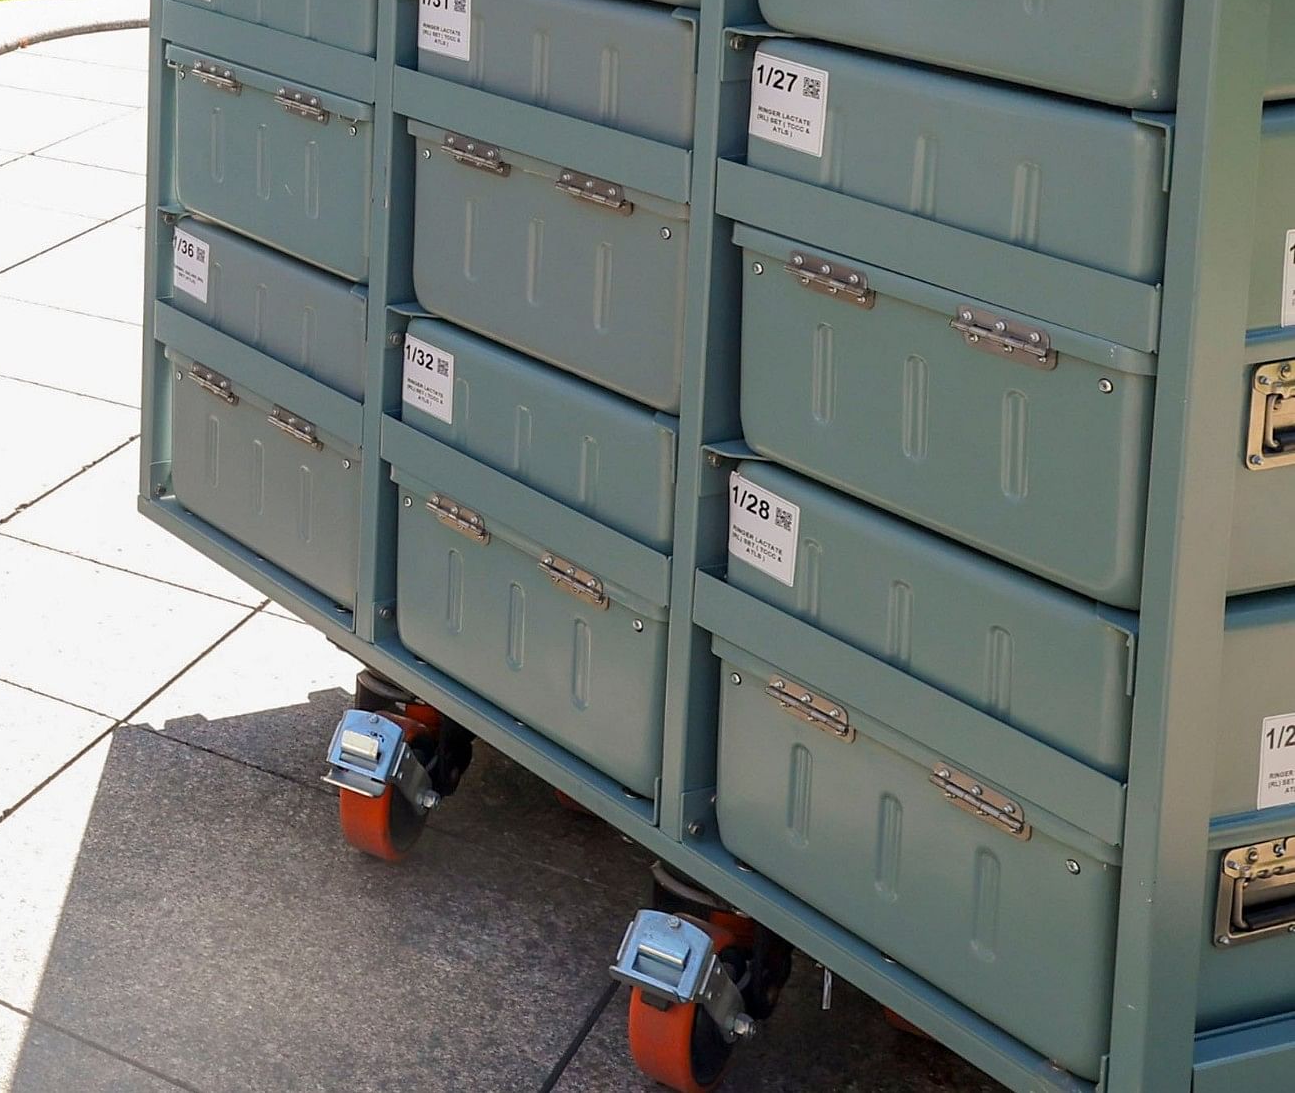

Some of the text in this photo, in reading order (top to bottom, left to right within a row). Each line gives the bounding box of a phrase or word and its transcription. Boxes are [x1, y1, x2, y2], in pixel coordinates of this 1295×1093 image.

[757, 64, 798, 92] 1/27
[758, 105, 811, 126] RINGER LACTATE
[174, 236, 194, 258] 1/36
[406, 344, 434, 371] 1/32
[732, 485, 770, 520] 1/28
[732, 524, 783, 555] RINGER LACTATE
[1269, 769, 1293, 779] RINGER
